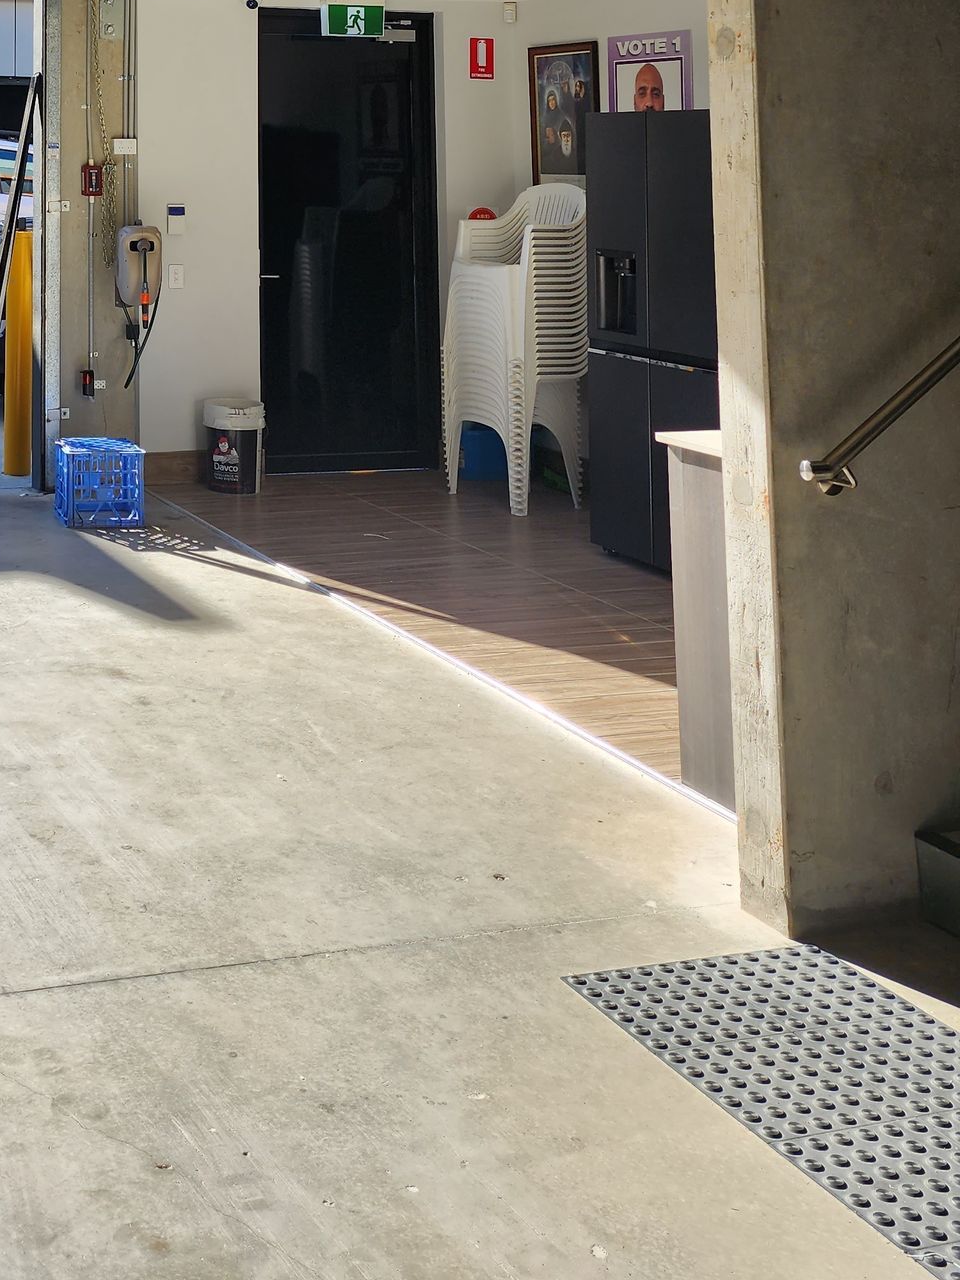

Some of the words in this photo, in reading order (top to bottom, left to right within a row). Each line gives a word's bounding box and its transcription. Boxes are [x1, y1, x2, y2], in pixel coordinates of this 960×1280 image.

[616, 37, 667, 56] VOTE
[672, 36, 681, 52] 1
[214, 462, 239, 472] Davco
